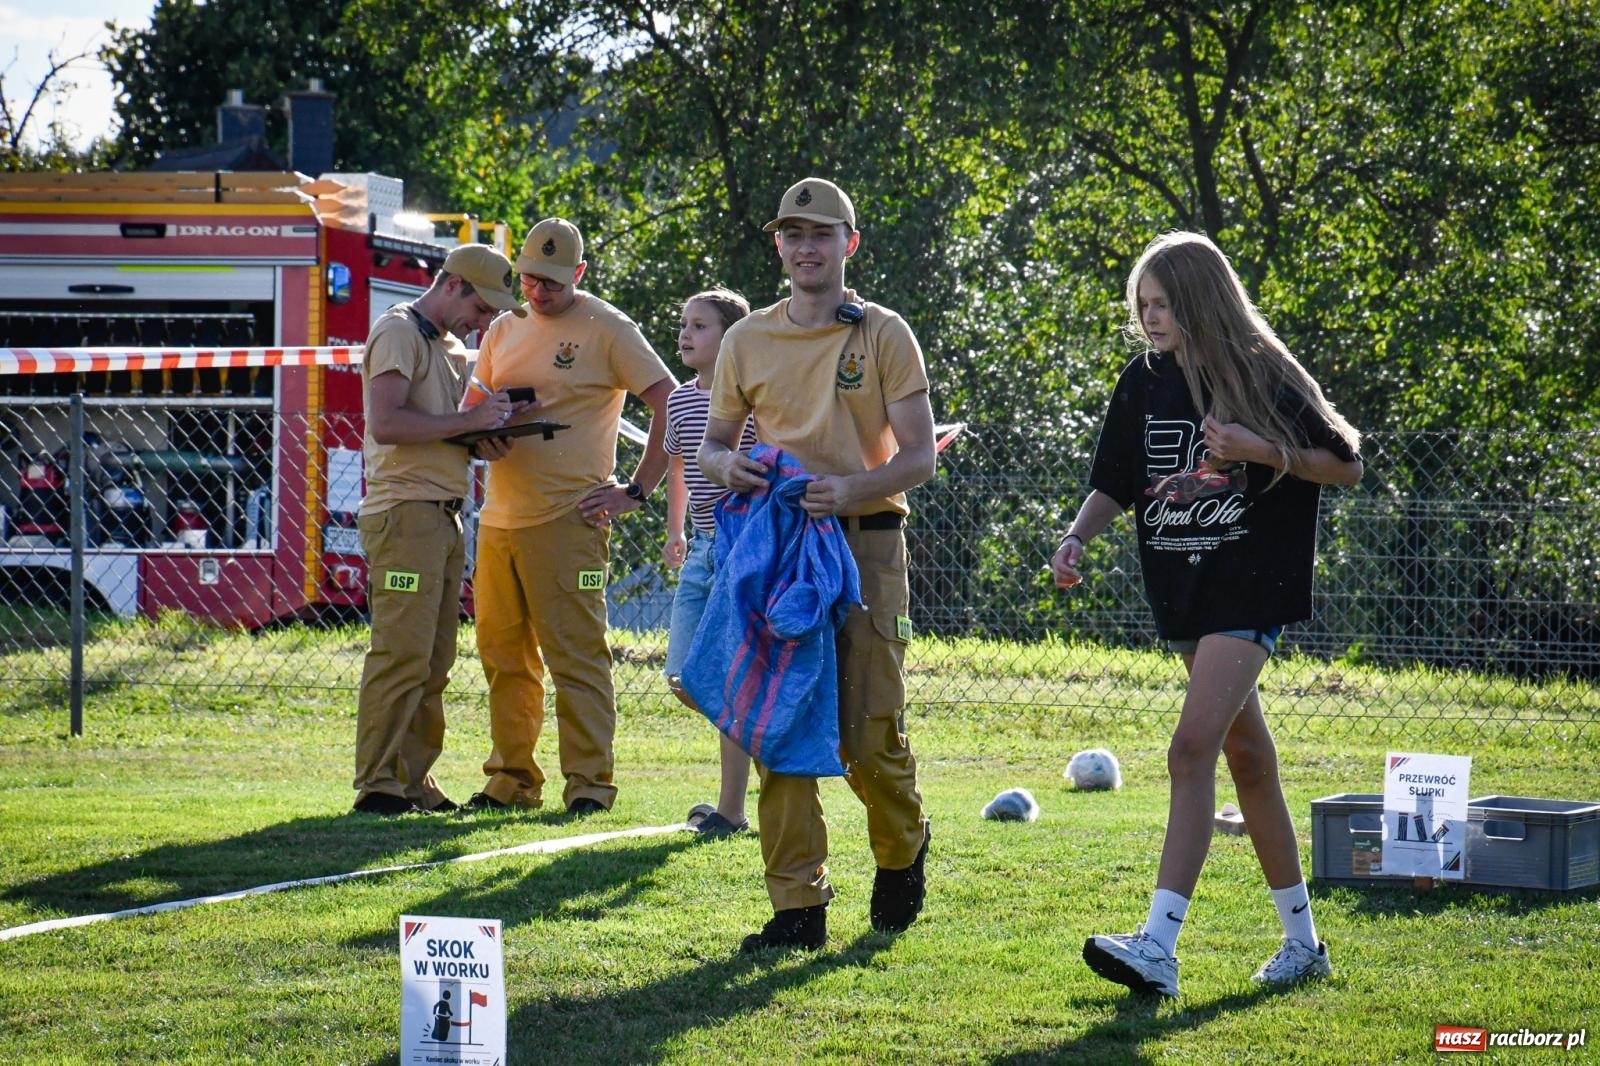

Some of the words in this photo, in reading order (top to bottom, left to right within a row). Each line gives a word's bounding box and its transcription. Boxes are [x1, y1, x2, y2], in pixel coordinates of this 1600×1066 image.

[179, 225, 280, 237] DRAGON
[1144, 496, 1200, 535] Speed
[390, 575, 415, 589] OSP
[582, 574, 602, 587] OSP
[1399, 773, 1456, 785] PRZEWRÓĆ
[1409, 786, 1445, 798] SŁUPKI
[426, 938, 475, 959] SKOK
[413, 960, 428, 976] W
[432, 961, 490, 979] WORKU
[464, 1057, 480, 1065] worku
